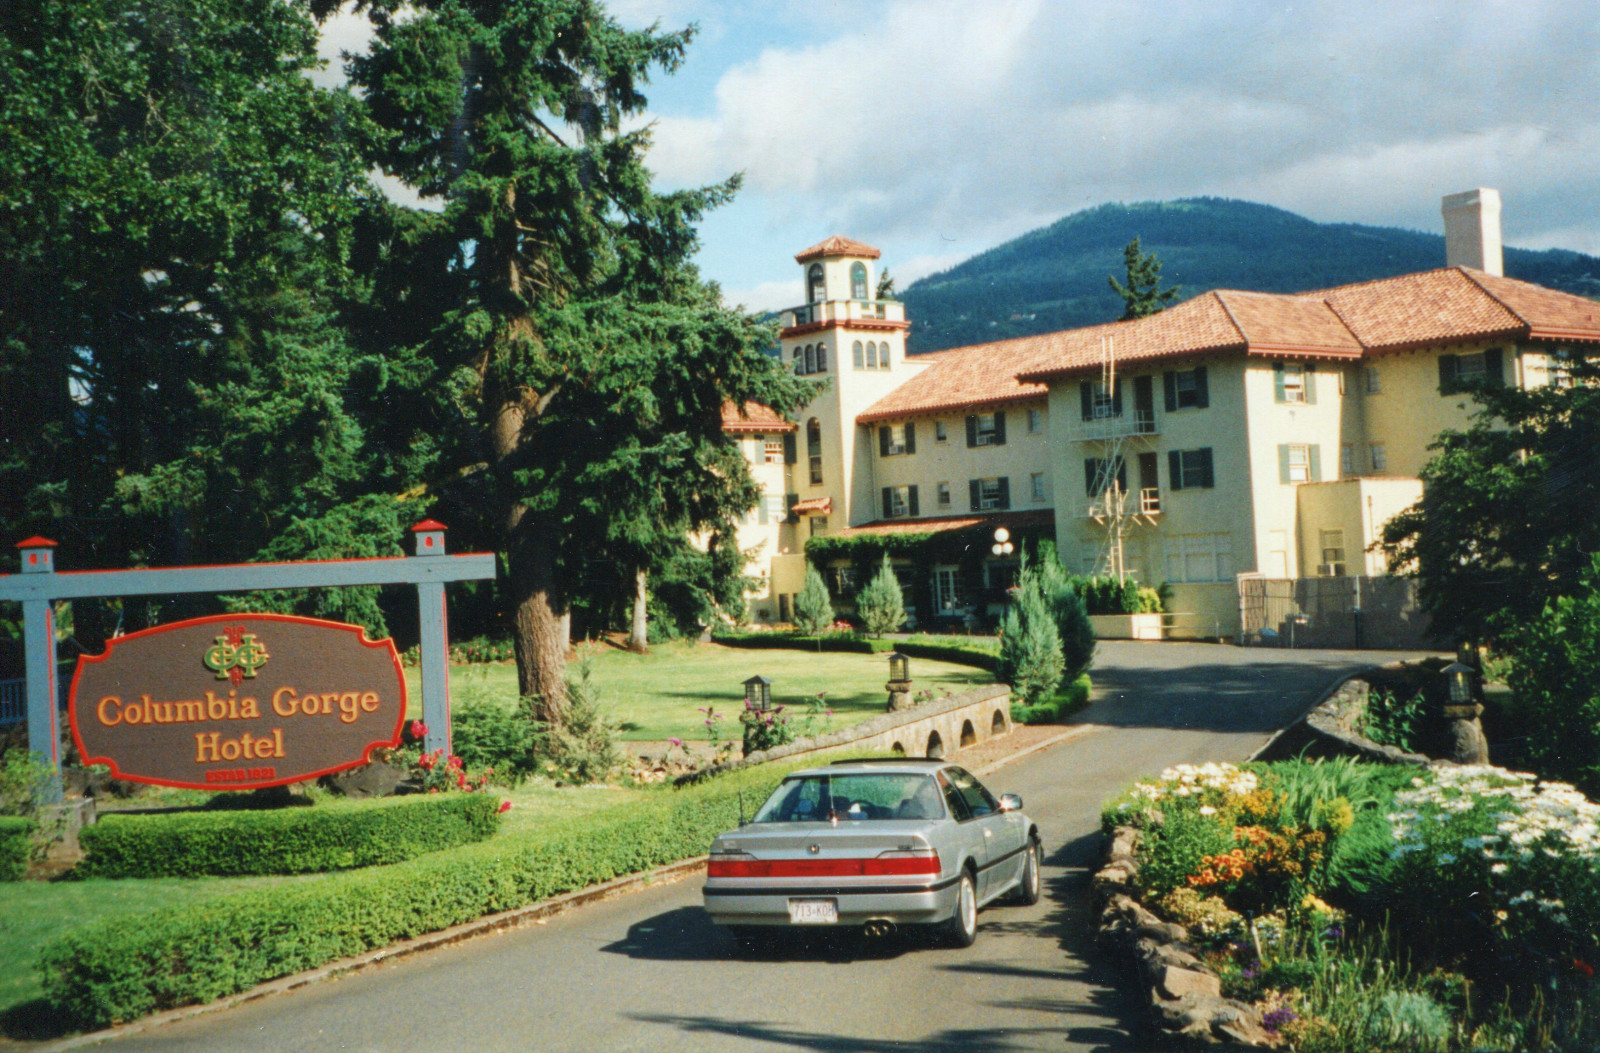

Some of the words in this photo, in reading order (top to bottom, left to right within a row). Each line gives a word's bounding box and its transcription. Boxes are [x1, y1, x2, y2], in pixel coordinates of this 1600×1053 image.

[98, 691, 260, 725] Columbia
[272, 687, 380, 724] Gorge
[195, 729, 285, 762] Hotel
